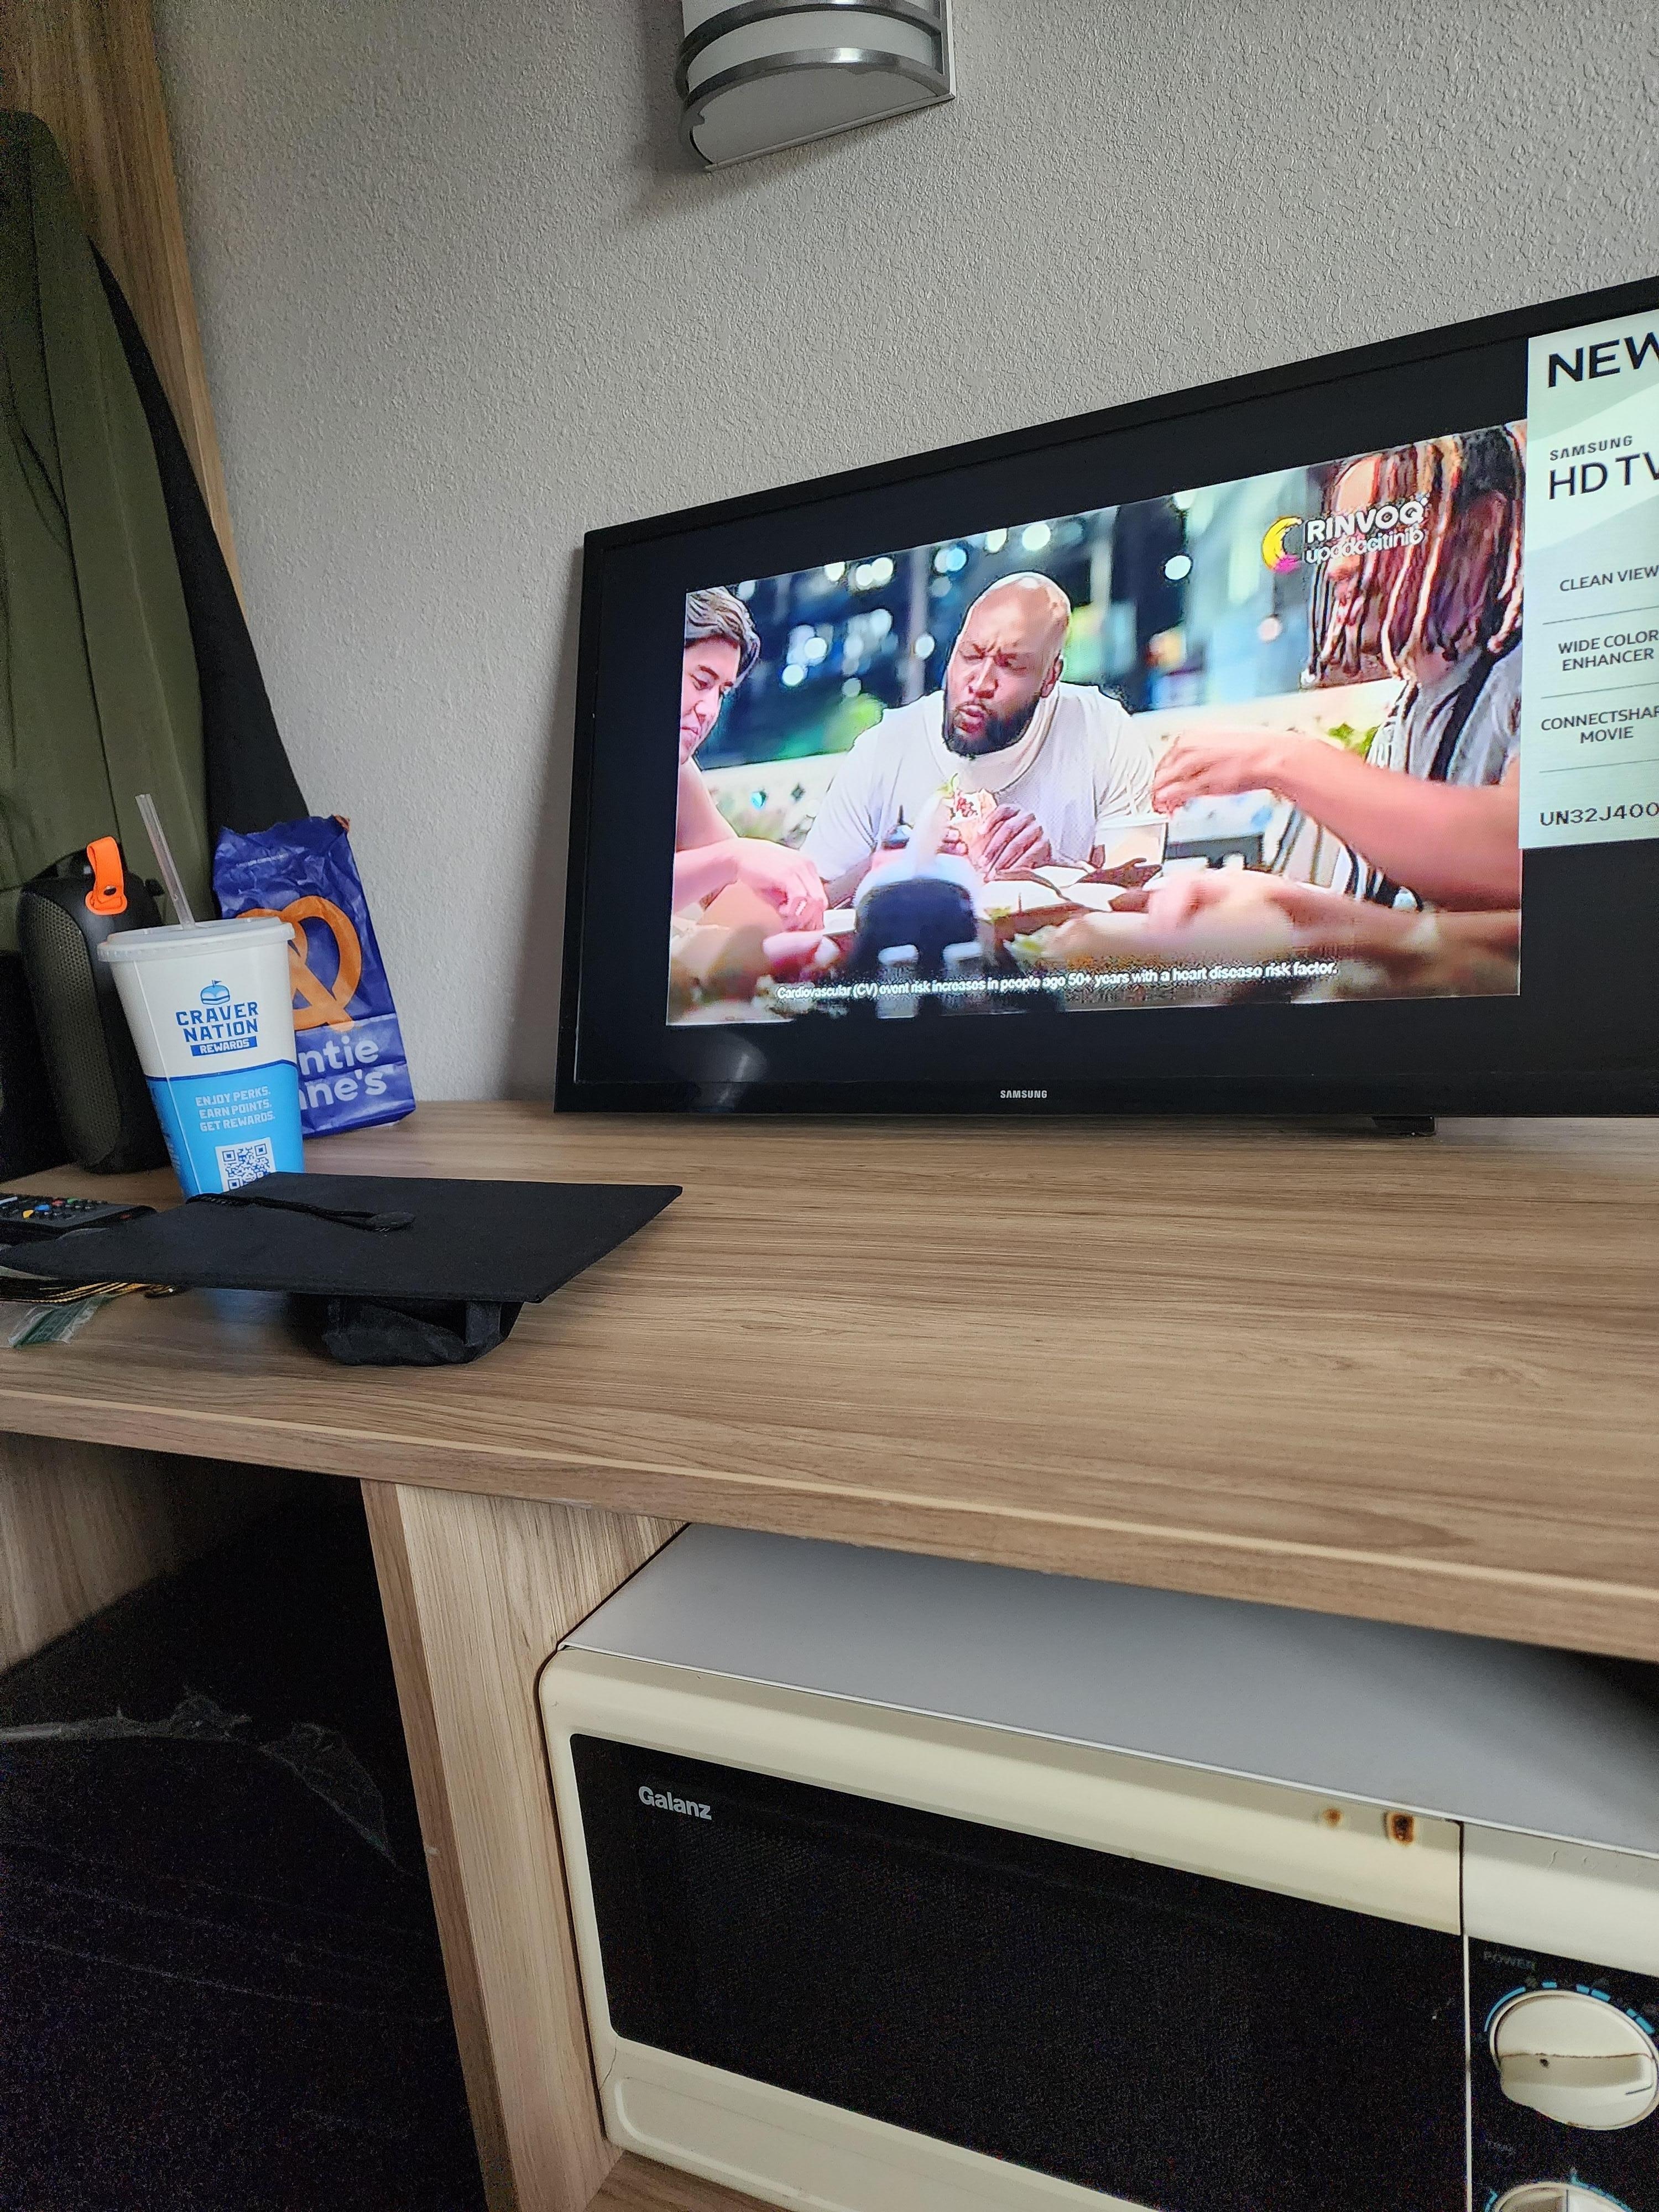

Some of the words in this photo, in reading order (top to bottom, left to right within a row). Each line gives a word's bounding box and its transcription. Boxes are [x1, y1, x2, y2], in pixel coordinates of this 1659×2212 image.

[1547, 332, 1659, 388] NEW
[1550, 435, 1633, 461] SAMSUNG
[1307, 499, 1426, 544] RINVOQ
[1559, 572, 1613, 591] CLEAN
[1618, 565, 1659, 582] VIEW
[1558, 637, 1600, 654] WIDE
[1604, 629, 1659, 648] COLOR
[1562, 648, 1654, 671] ENHANCER
[1580, 726, 1634, 744] MOVIE
[1540, 802, 1659, 826] UN32J400
[776, 984, 852, 999] Cardiovascular
[853, 983, 878, 998] (CV)
[911, 980, 930, 993] risk
[987, 977, 999, 990] in
[1067, 973, 1092, 986] 50+
[1094, 973, 1130, 988] years
[1133, 969, 1158, 983] with
[1161, 971, 1171, 982] a
[1172, 968, 1207, 981] heart
[1265, 963, 1291, 978] risk
[175, 1001, 259, 1026] CRAVER
[183, 1018, 258, 1043] NATION
[199, 1037, 250, 1054] REWARDS
[195, 1092, 231, 1107] ENJOY
[233, 1086, 271, 1100] PERKS.
[1000, 1090, 1047, 1098] SAMSUNG
[199, 1106, 230, 1119] EARN
[232, 1099, 272, 1115] POINTS.
[199, 1120, 221, 1133] GET
[223, 1111, 275, 1129] REWARDS.
[638, 1786, 712, 1820] Galanz
